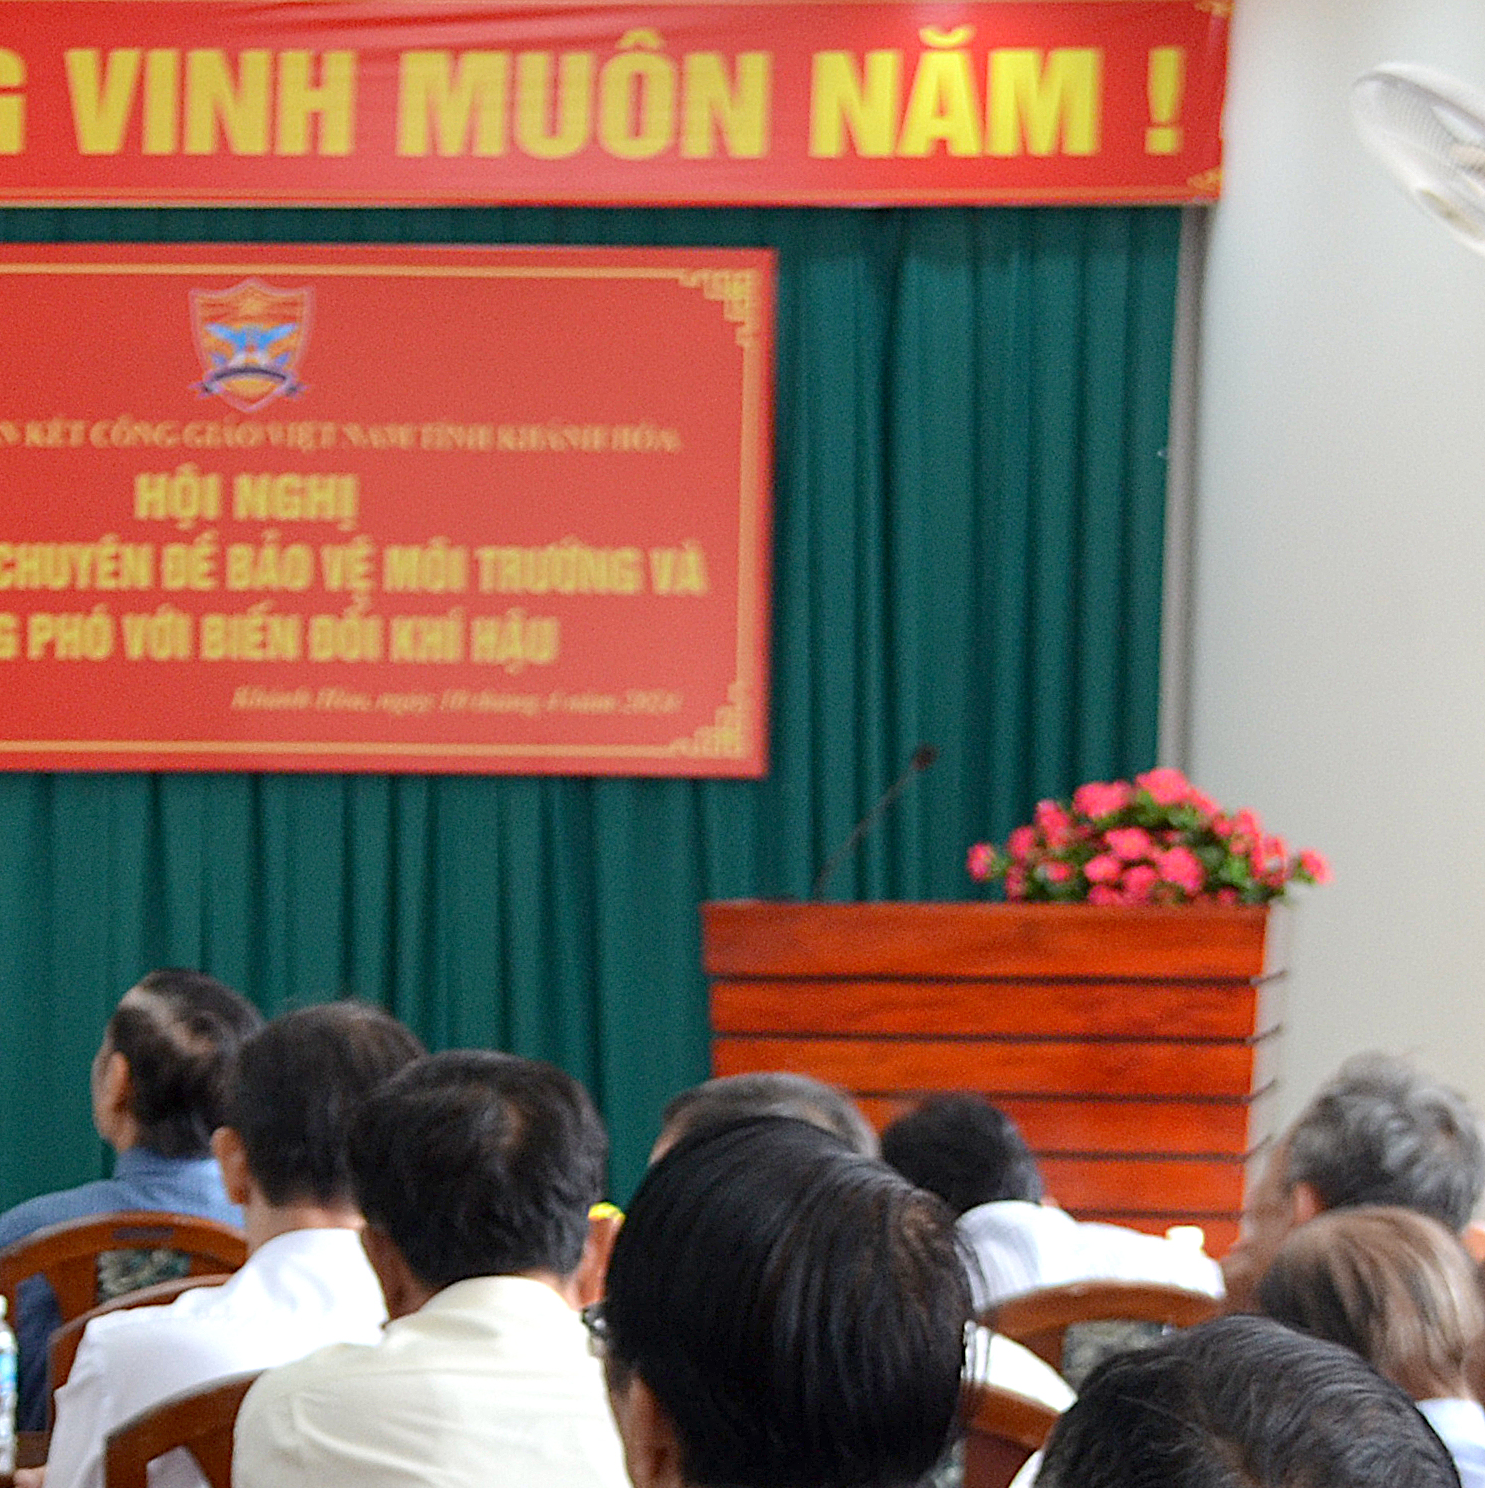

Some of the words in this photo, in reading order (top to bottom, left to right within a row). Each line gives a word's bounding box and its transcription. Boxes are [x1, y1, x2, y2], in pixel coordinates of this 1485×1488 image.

[65, 47, 355, 156] VINH
[399, 29, 772, 159] MUÔN
[809, 24, 1104, 159] NĂM
[1145, 47, 1185, 156] !
[134, 462, 222, 530] HỘI
[234, 472, 361, 531] NGHỊ
[161, 530, 219, 590] ĐỀ
[228, 529, 314, 590] BẢO
[320, 533, 377, 601] VỆ
[384, 535, 469, 593] MÔI
[474, 534, 643, 595] TRƯỜNG
[650, 536, 710, 597] VÀ
[28, 602, 112, 660] PHÓ
[122, 602, 191, 660] VỚI
[201, 599, 300, 661] BIẾN
[308, 596, 384, 662] ĐỔI
[390, 605, 466, 664] KHÍ
[471, 607, 561, 675] HẬU
